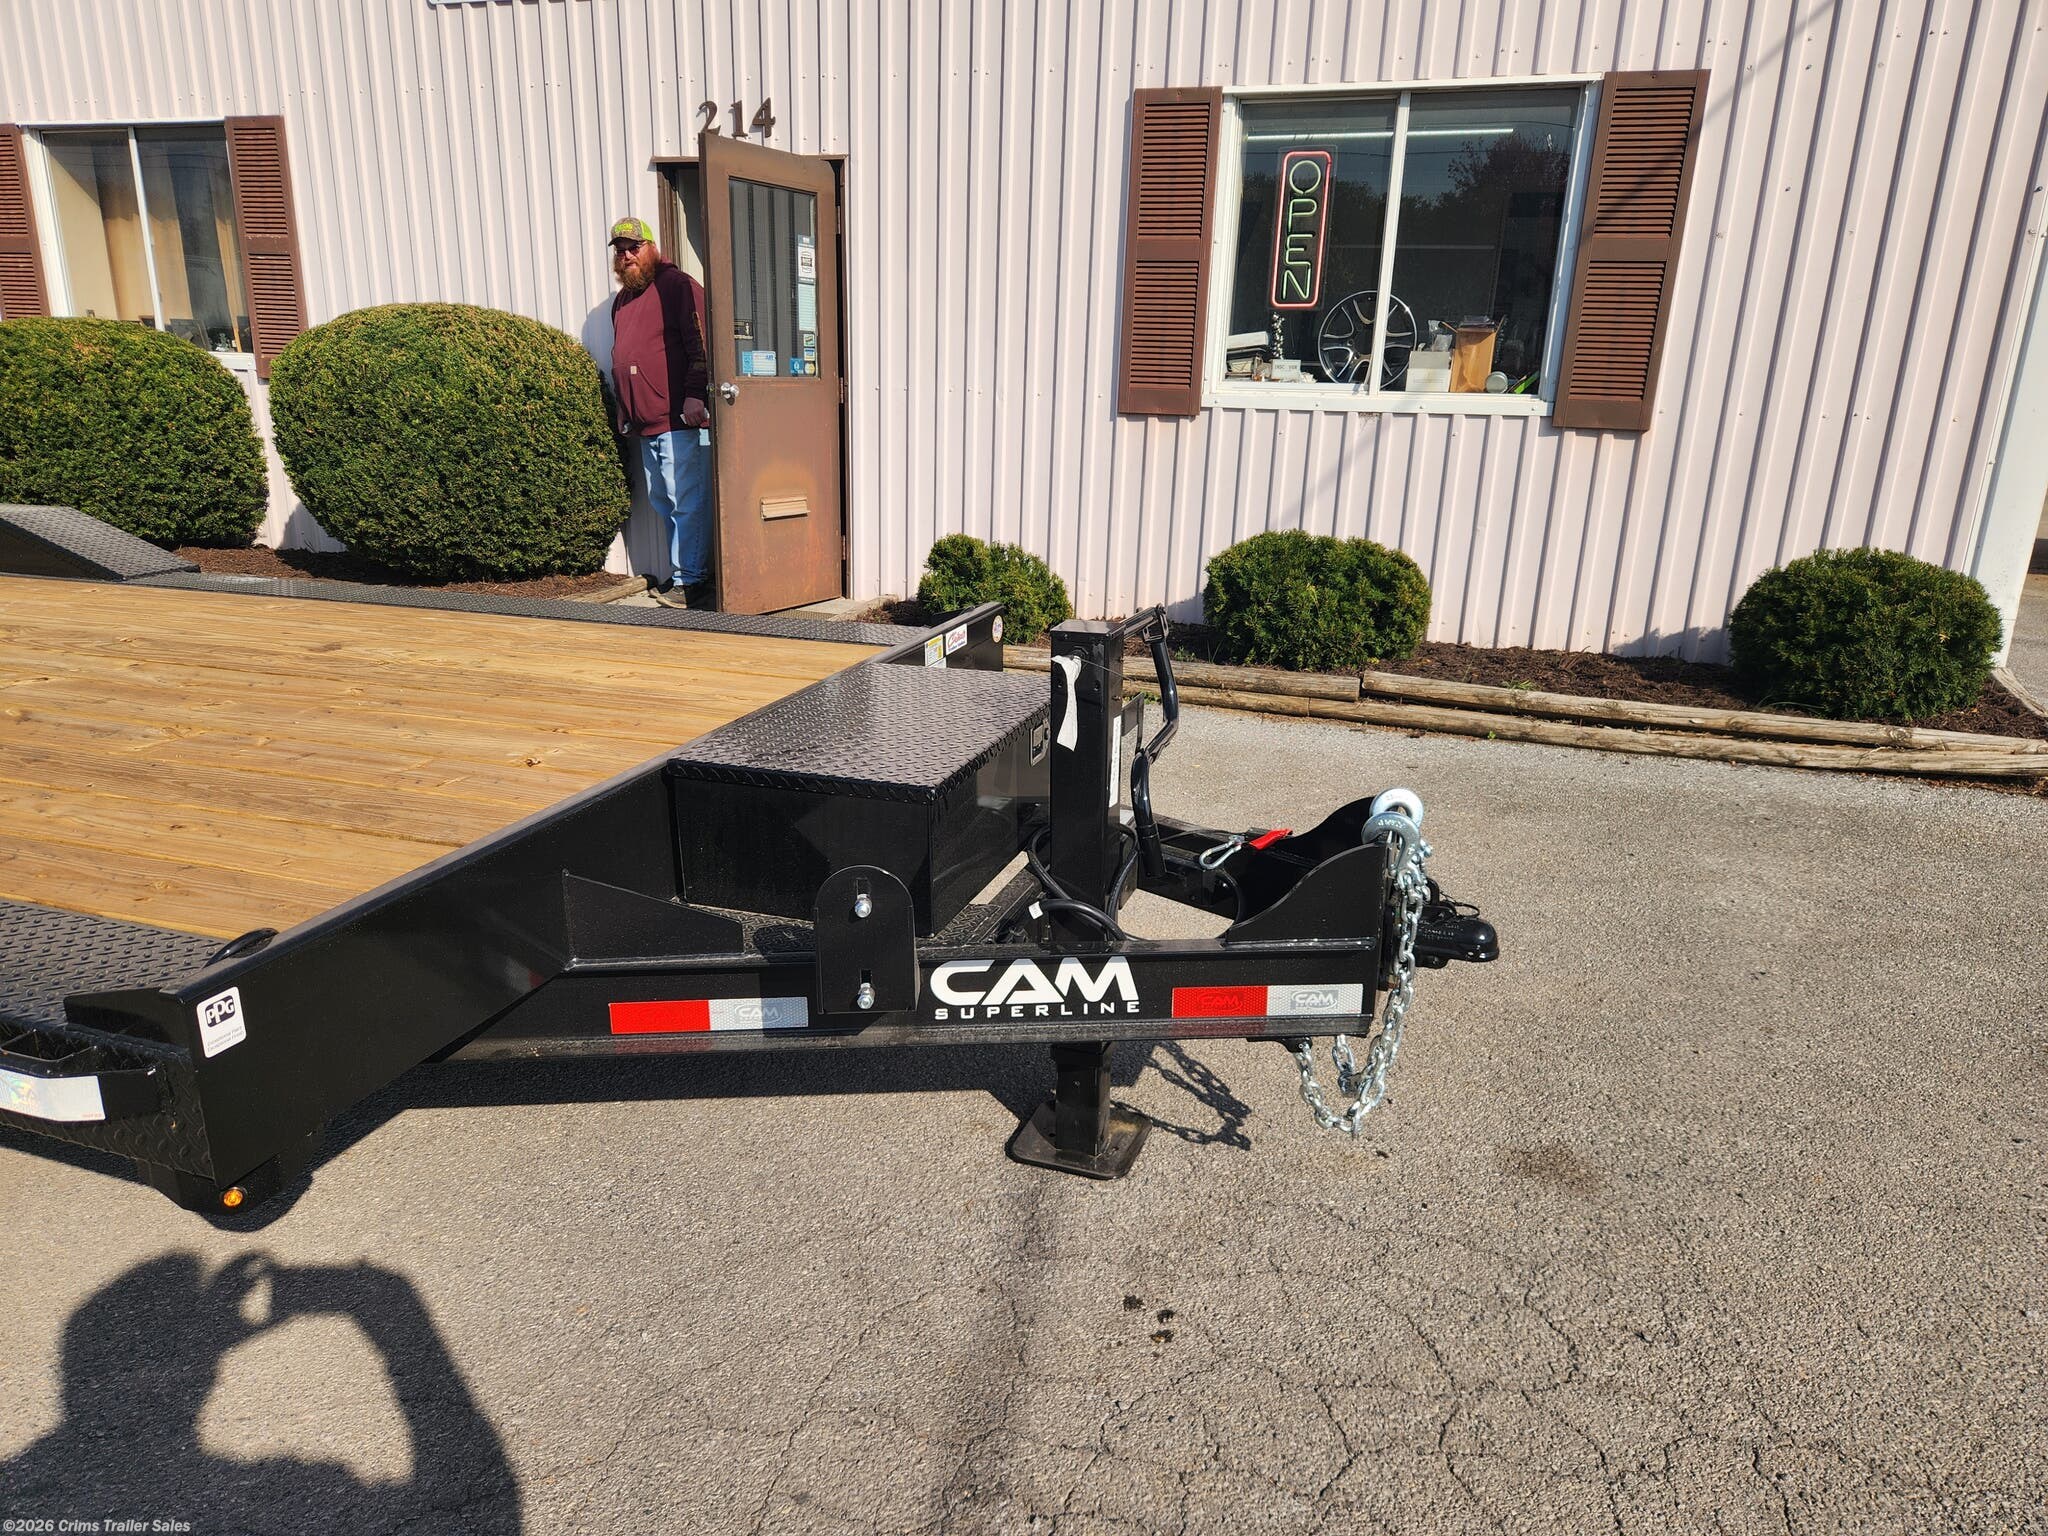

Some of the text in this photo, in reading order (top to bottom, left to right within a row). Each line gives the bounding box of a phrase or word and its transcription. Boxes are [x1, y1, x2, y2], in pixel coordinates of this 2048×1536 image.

[697, 97, 776, 138] 214
[1281, 160, 1322, 300] OPEN
[930, 956, 1139, 1006] CAM
[206, 999, 235, 1024] PPG
[737, 1006, 779, 1018] CAM
[934, 1000, 1141, 1020] SUPERLINE
[1294, 993, 1335, 1006] CAM
